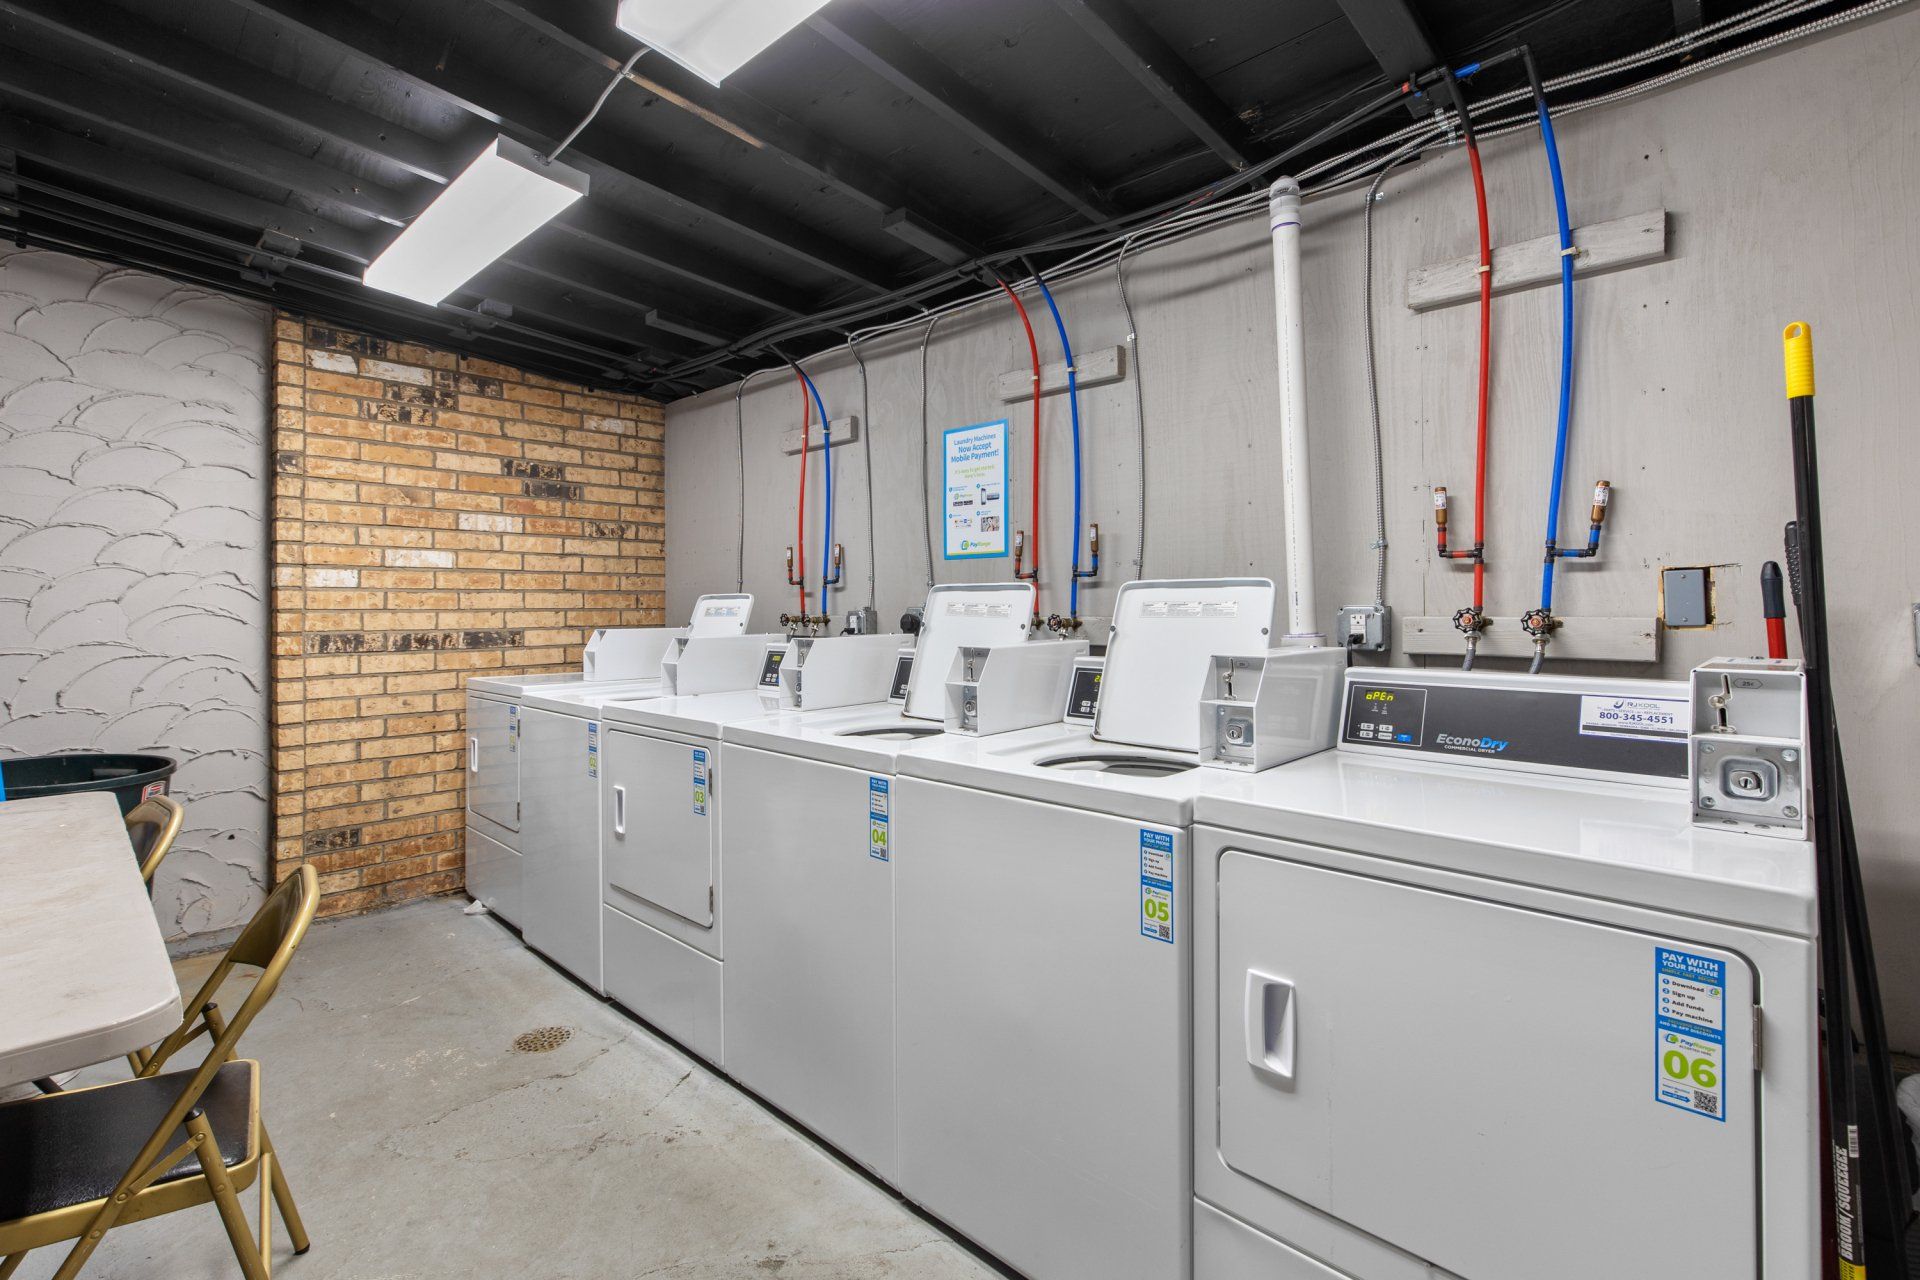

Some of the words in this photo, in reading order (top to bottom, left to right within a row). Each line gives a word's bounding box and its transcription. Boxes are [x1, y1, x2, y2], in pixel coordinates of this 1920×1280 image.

[953, 437, 973, 446] Laundry
[974, 434, 996, 443] Machines
[958, 446, 971, 454] Now
[973, 442, 992, 452] Accept
[951, 454, 970, 463] Mobile
[1599, 711, 1673, 724] 800-345-4551
[1436, 733, 1508, 750] EconoDry
[1444, 744, 1476, 752] COMMERCIAL
[695, 791, 705, 803] 03
[872, 829, 887, 845] 04
[1143, 832, 1155, 840] PAY
[1156, 834, 1170, 842] WITH
[1144, 898, 1169, 922] 05
[1662, 952, 1684, 963] PAY
[1686, 956, 1719, 971] WITH
[1662, 960, 1686, 971] YOUR
[1688, 965, 1719, 978] PHONE
[1672, 980, 1705, 992] Download
[1672, 990, 1684, 999] Sign
[1686, 1003, 1705, 1012] funds
[1685, 1013, 1713, 1023] machine
[1664, 1050, 1717, 1088] 06
[1836, 1145, 1854, 1261] BROOM/SQUEEGEE
